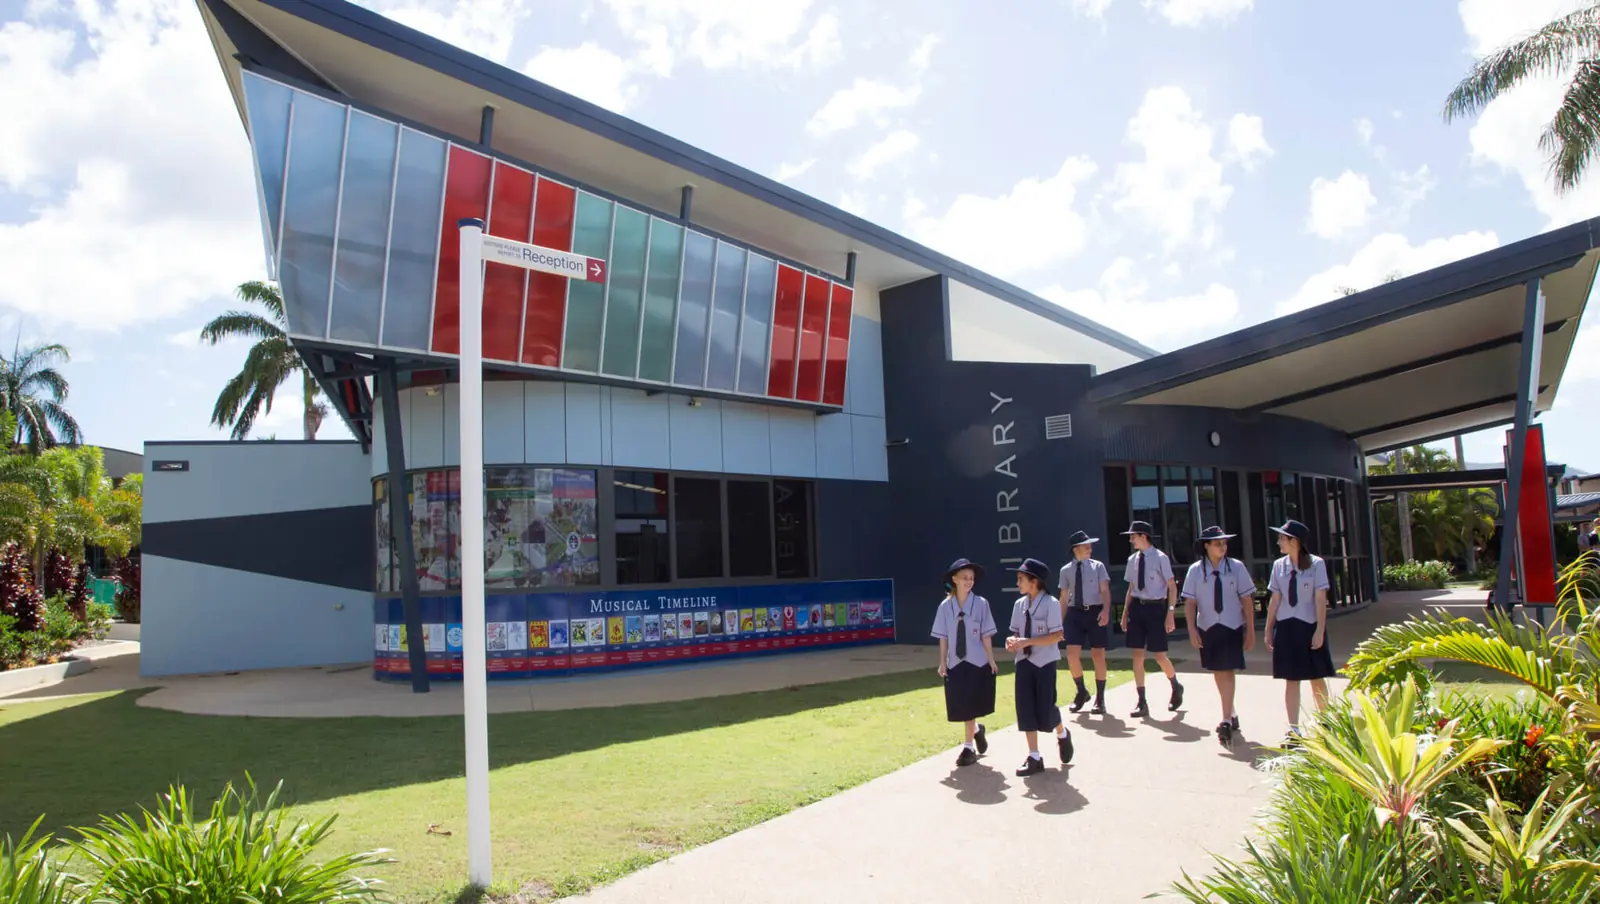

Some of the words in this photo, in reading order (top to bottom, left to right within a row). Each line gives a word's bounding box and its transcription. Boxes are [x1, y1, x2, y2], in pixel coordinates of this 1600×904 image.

[522, 247, 584, 272] Reception
[590, 599, 651, 613] MUSICAL
[657, 596, 717, 610] TIMELINE
